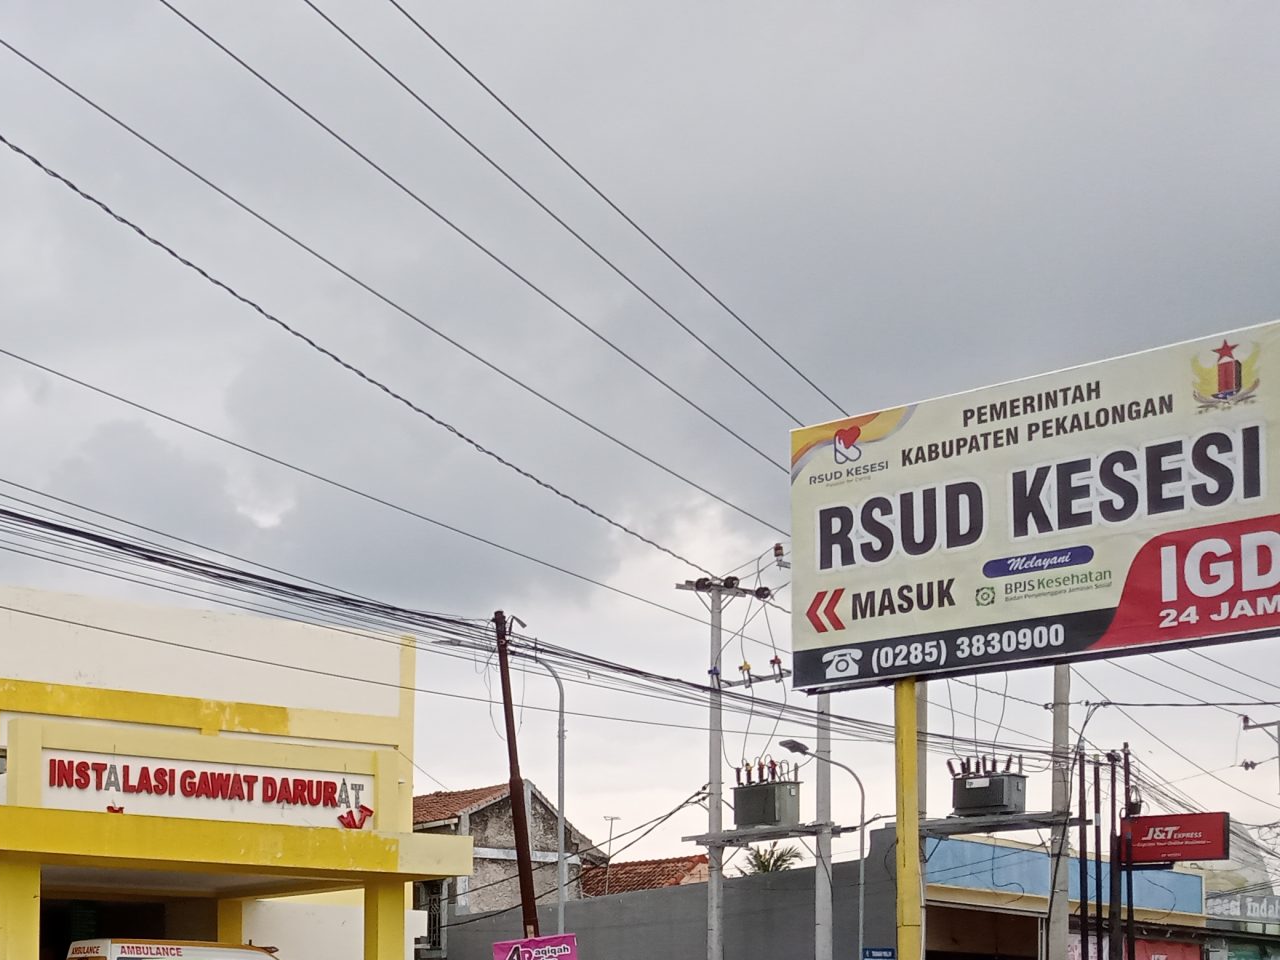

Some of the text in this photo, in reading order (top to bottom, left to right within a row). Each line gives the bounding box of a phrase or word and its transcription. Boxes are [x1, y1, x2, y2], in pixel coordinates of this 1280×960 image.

[962, 381, 1101, 427] PEMERINTAH
[901, 394, 1174, 467] KABUPATEN PEKALONGAN
[809, 470, 843, 485] RSUD
[846, 461, 889, 478] KESESI
[819, 425, 1261, 570] RSUD KESESI
[1007, 551, 1072, 571] Melayani
[1160, 530, 1280, 603] IGD
[851, 578, 956, 621] MASUK
[1004, 570, 1112, 595] BPJS Kesehatan
[1159, 595, 1280, 629] 24 JAM
[871, 623, 1065, 674] (0285) 3830900
[49, 759, 364, 809] INSTALASI GAWAT DARURAT
[1141, 826, 1180, 841] J&T
[120, 945, 183, 957] AMBULANCE
[534, 945, 570, 957] aqiqah
